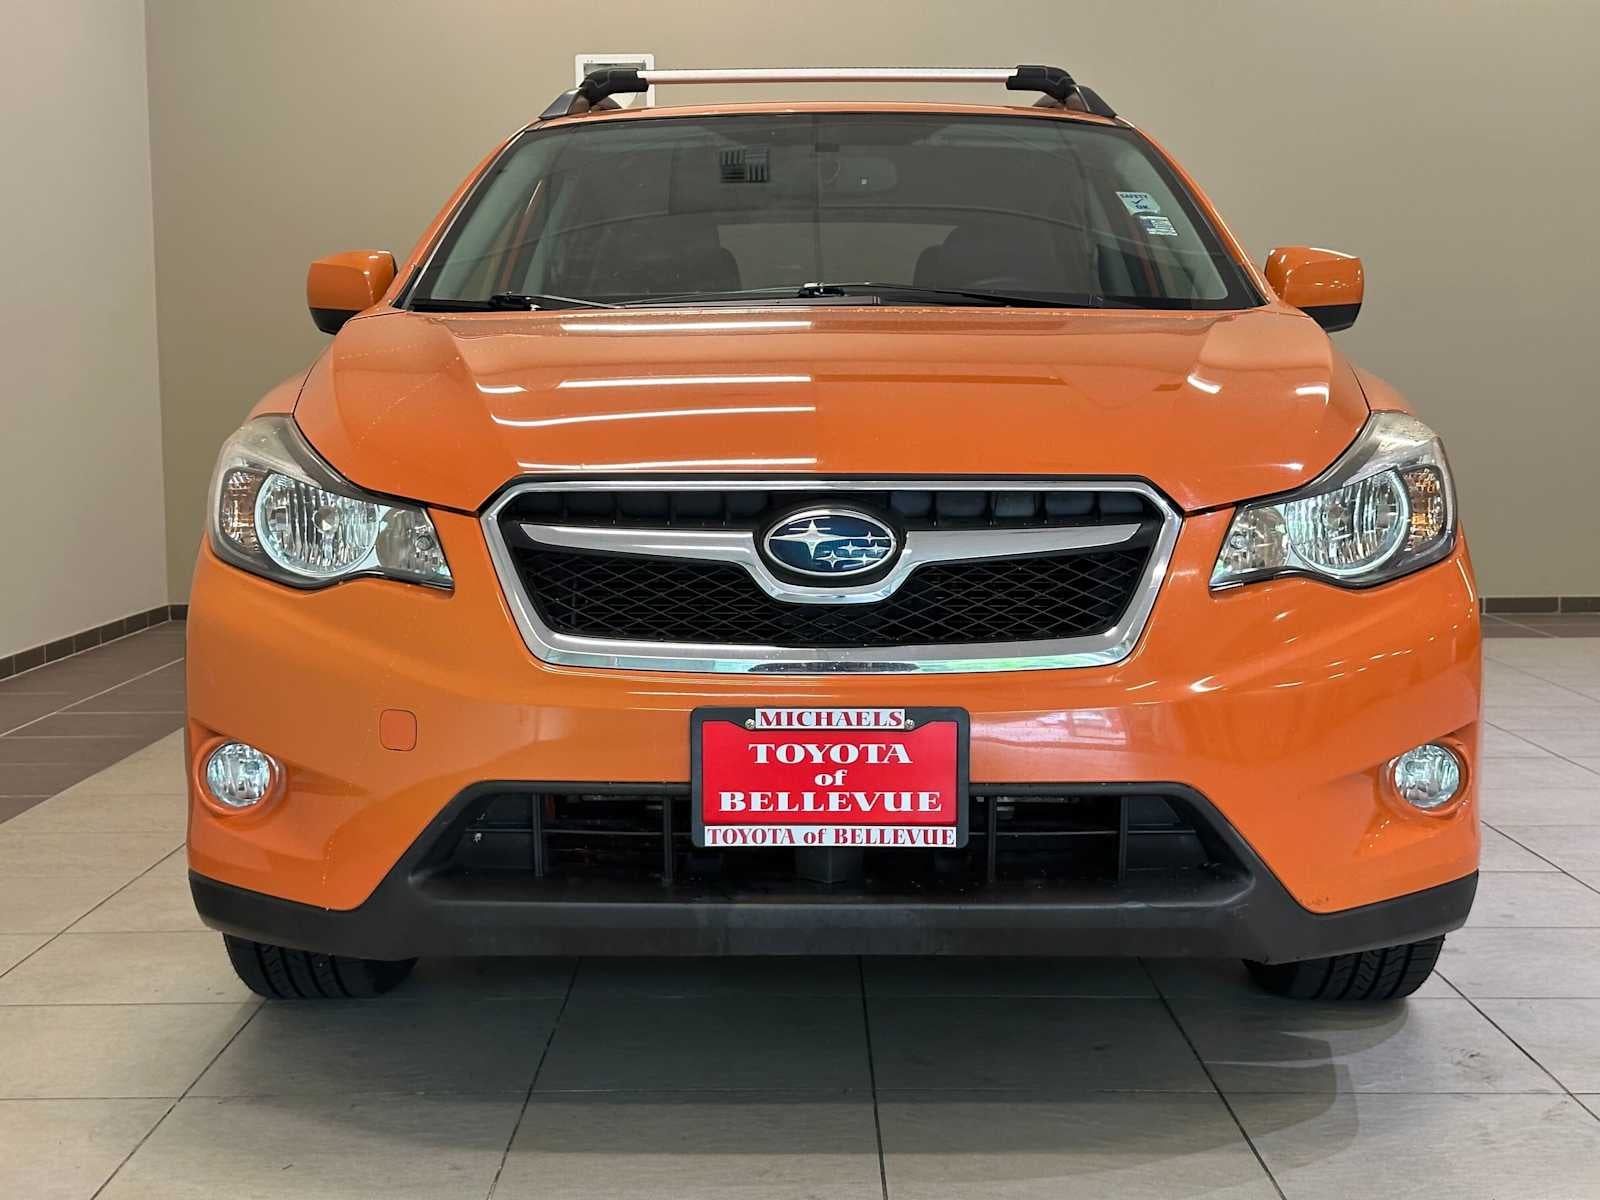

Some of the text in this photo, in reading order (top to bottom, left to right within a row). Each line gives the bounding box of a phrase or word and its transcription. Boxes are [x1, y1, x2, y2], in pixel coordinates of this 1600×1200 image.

[759, 711, 903, 727] MICHAELS
[748, 743, 913, 764] TOYOTA
[814, 770, 848, 786] of
[719, 791, 942, 812] BELLEVUE
[707, 828, 955, 846] TOYOTA of BELLEVUE
